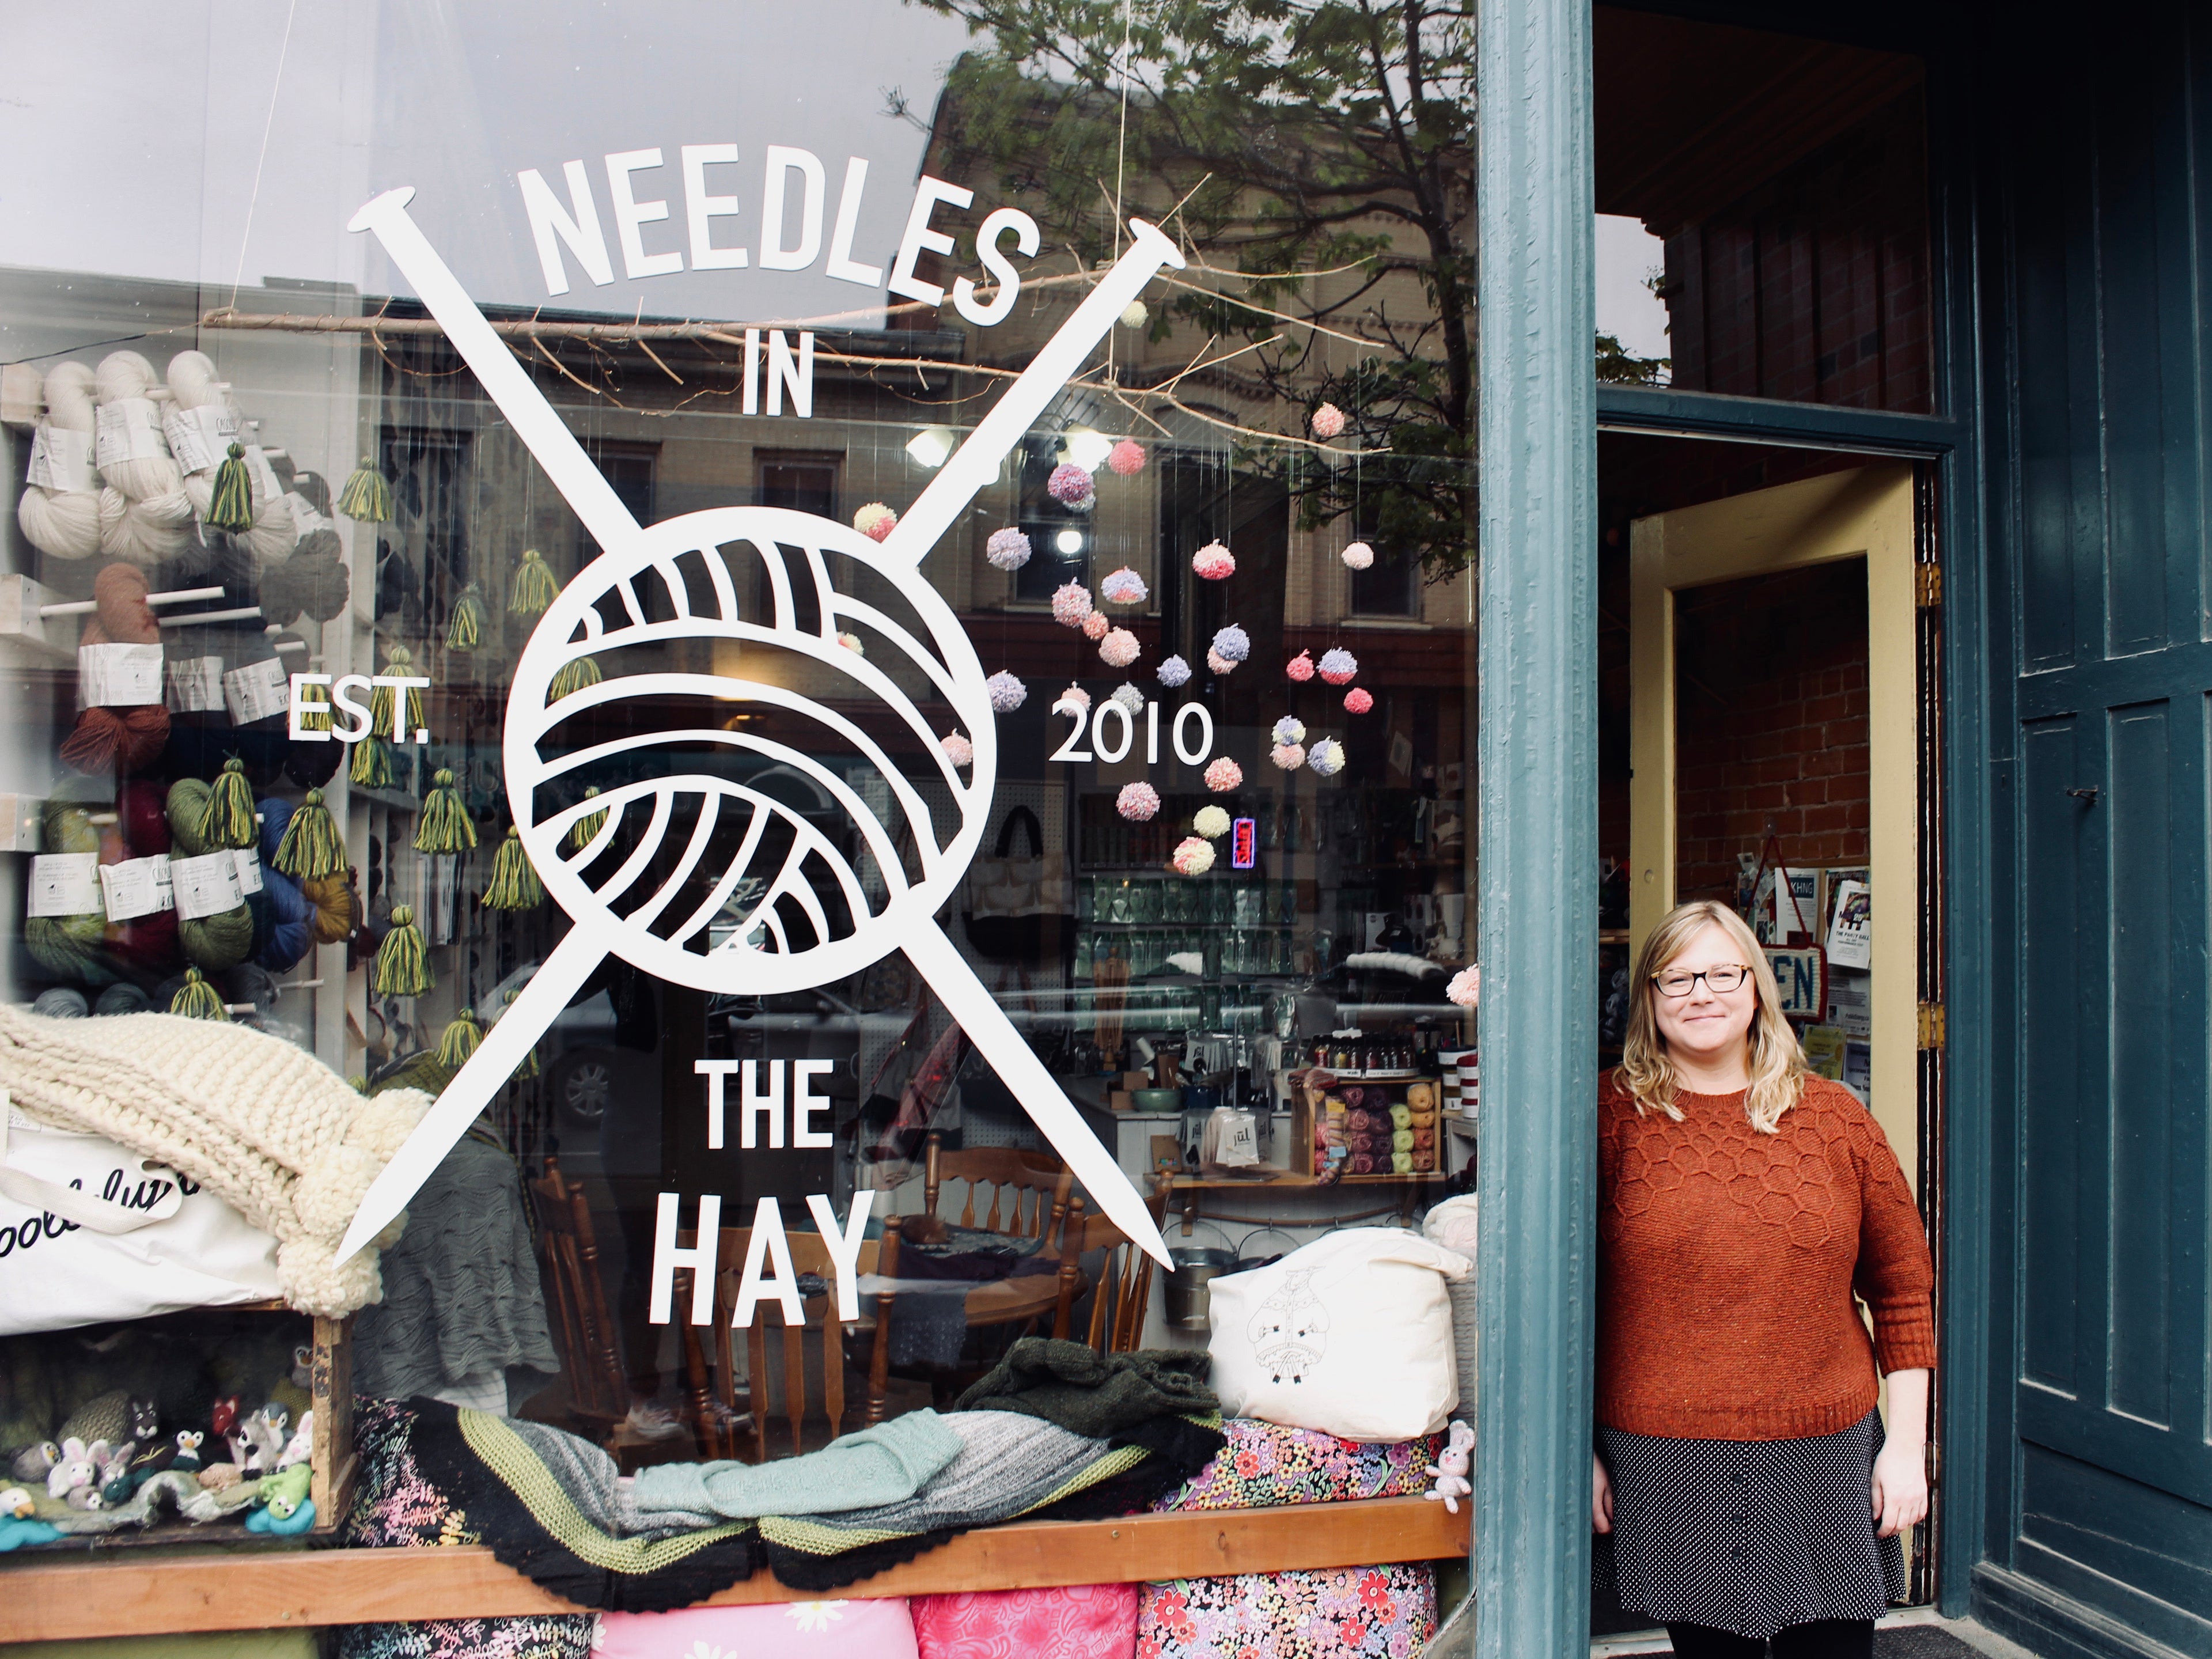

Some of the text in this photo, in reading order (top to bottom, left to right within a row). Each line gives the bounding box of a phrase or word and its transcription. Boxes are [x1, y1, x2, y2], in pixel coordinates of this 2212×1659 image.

[517, 143, 1040, 327] NEEDLES
[743, 328, 815, 419] IN
[289, 673, 430, 744] EST.
[1048, 698, 1214, 766] 2010
[1773, 956, 1813, 1009] EN
[695, 1059, 834, 1149] THE
[649, 1188, 876, 1328] HAY
